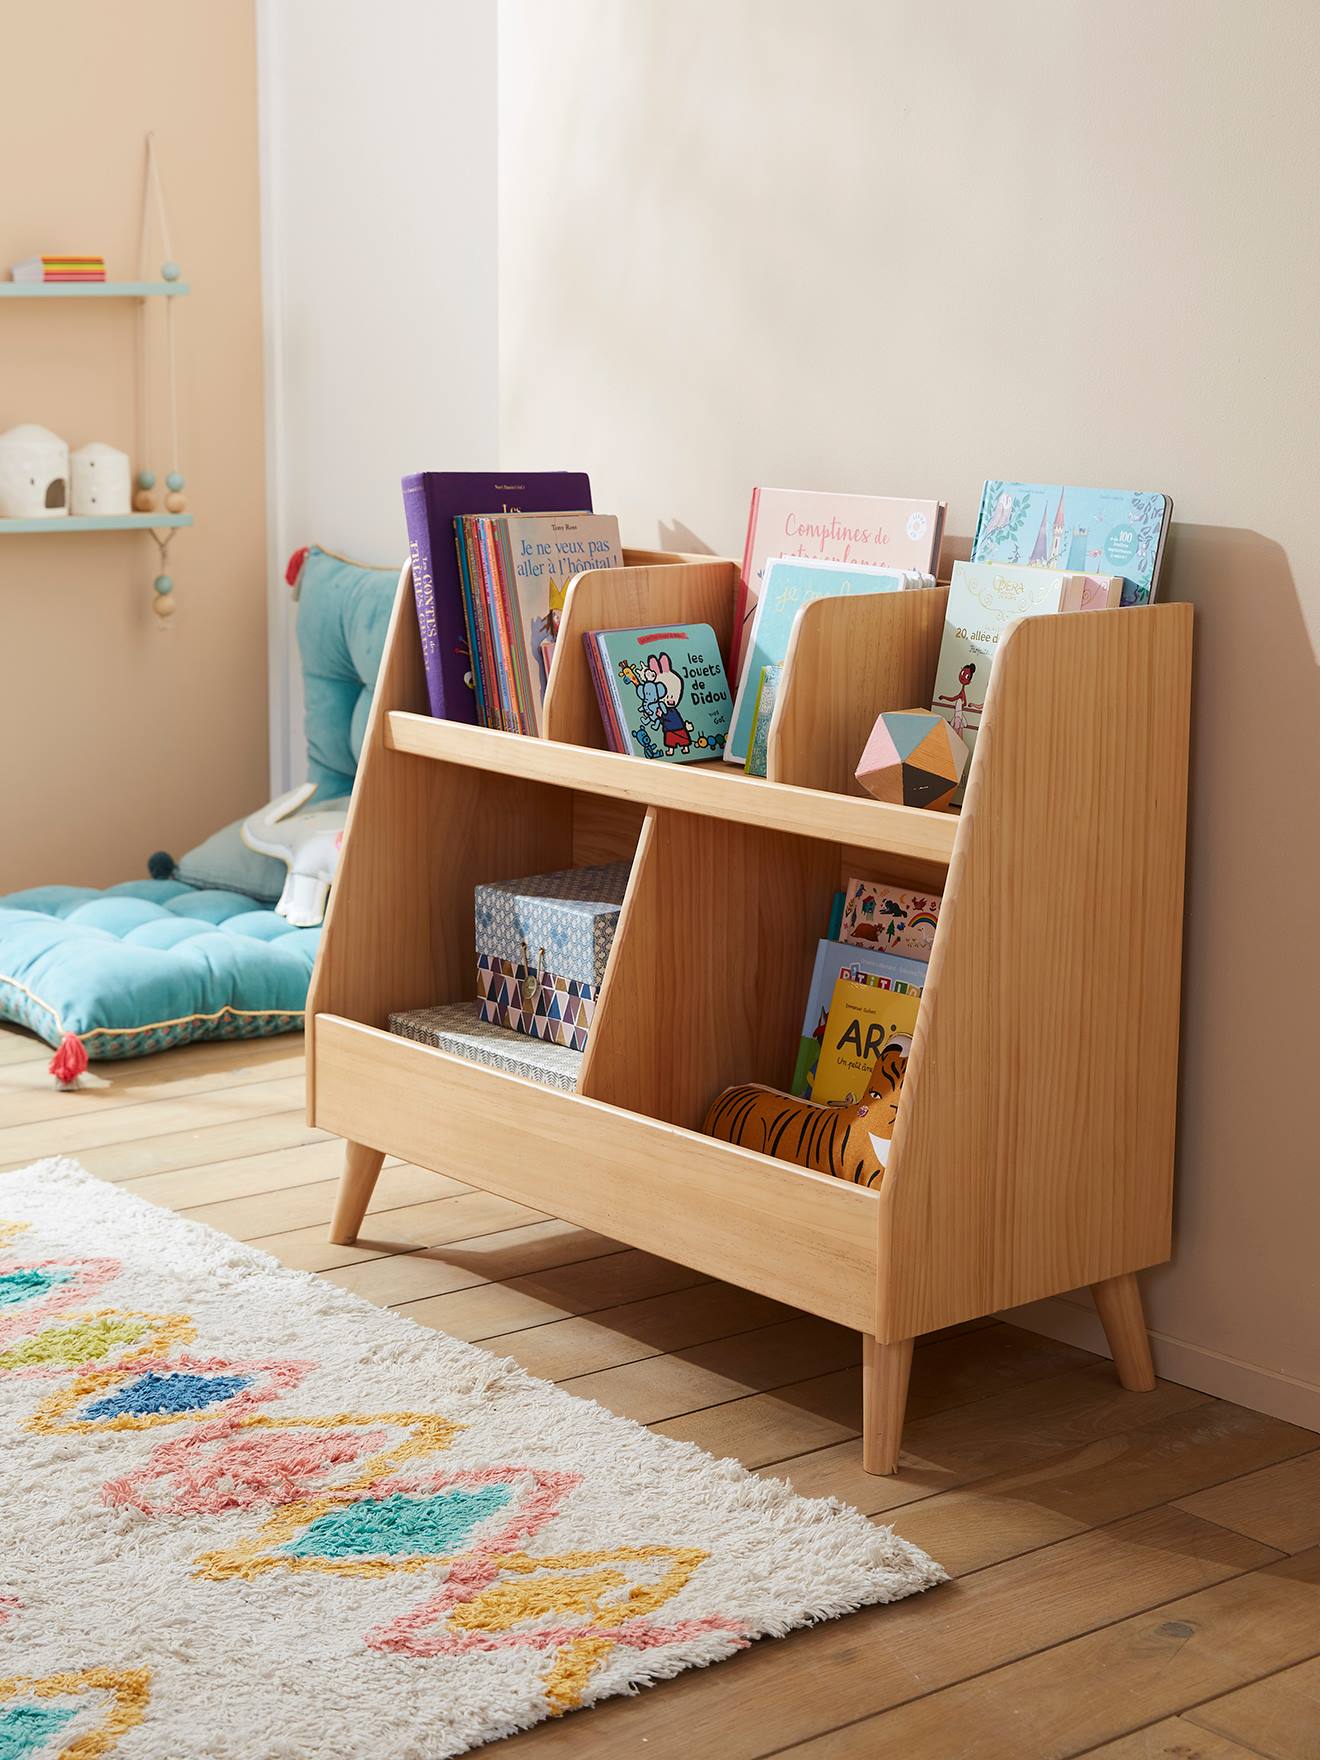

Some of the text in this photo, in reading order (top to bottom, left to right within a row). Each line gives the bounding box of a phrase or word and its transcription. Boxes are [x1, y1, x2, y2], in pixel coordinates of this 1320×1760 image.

[784, 511, 873, 552] Comptines
[874, 527, 890, 545] de
[520, 540, 610, 557] Je ne veux pas
[517, 559, 545, 577] aller
[547, 558, 556, 574] à
[421, 573, 438, 638] CONTES
[955, 627, 969, 641] 20,
[970, 630, 991, 642] allée
[687, 653, 704, 665] les
[691, 680, 706, 691] de
[691, 691, 727, 706] Didou
[836, 1018, 897, 1060] AR
